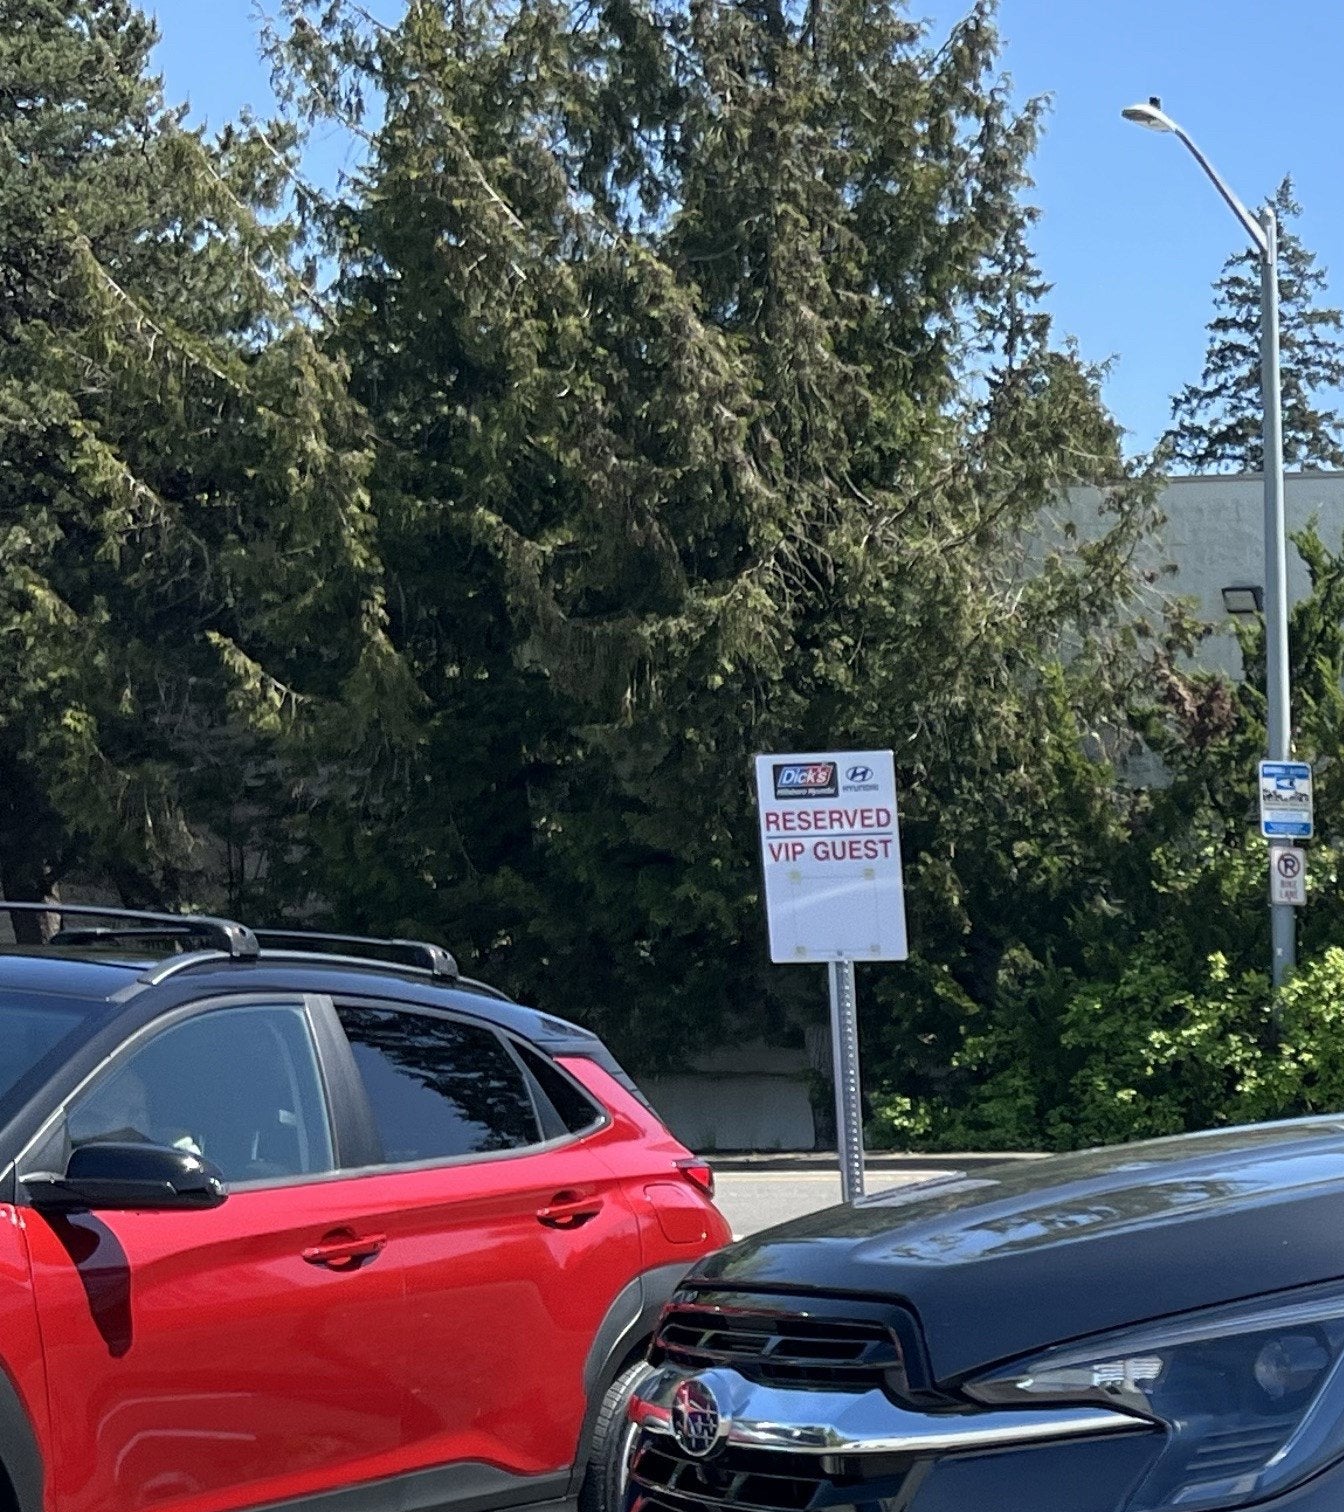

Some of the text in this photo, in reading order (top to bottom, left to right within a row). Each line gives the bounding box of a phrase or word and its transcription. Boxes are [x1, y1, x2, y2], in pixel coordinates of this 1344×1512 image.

[765, 808, 891, 831] RESERVED
[768, 839, 893, 862] VIP GUEST
